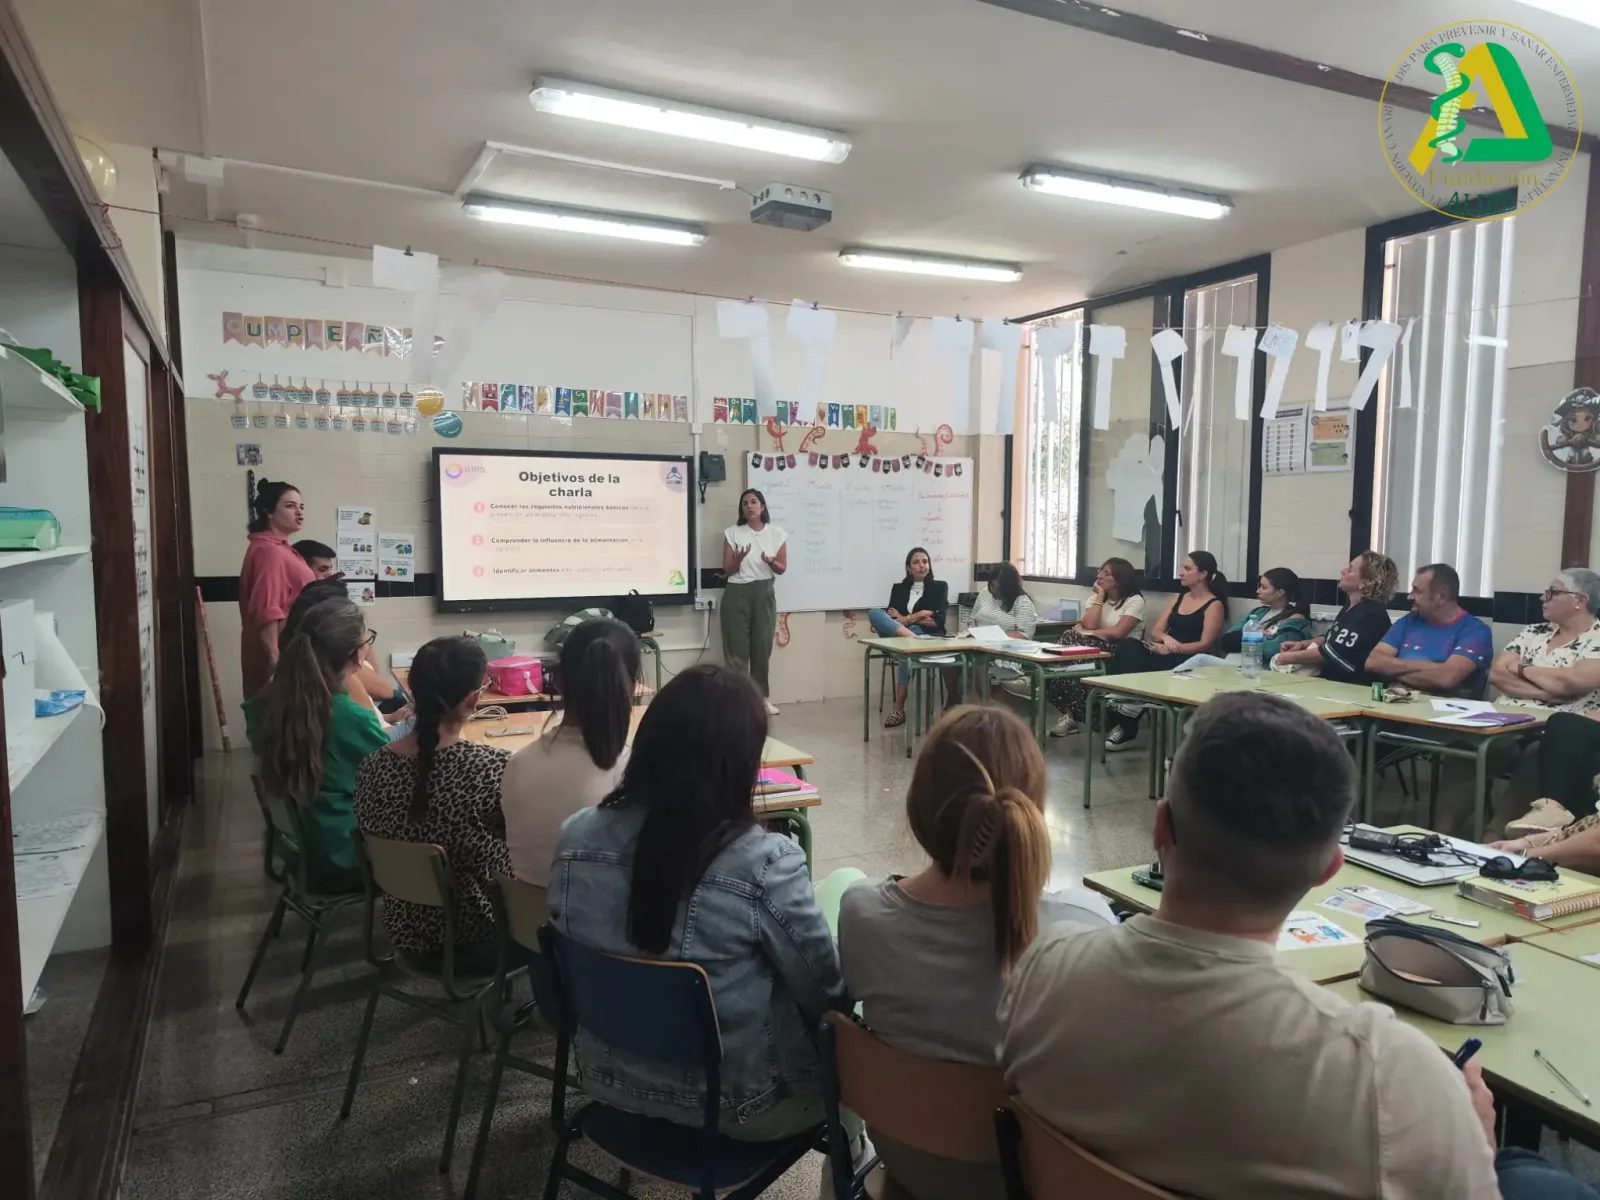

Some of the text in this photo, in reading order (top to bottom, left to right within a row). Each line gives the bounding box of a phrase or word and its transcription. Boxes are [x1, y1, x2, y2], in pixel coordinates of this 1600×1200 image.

[518, 471, 621, 484] Objetivos de la
[549, 487, 593, 497] charla
[493, 567, 527, 575] Identificar
[1334, 628, 1359, 648] 23
